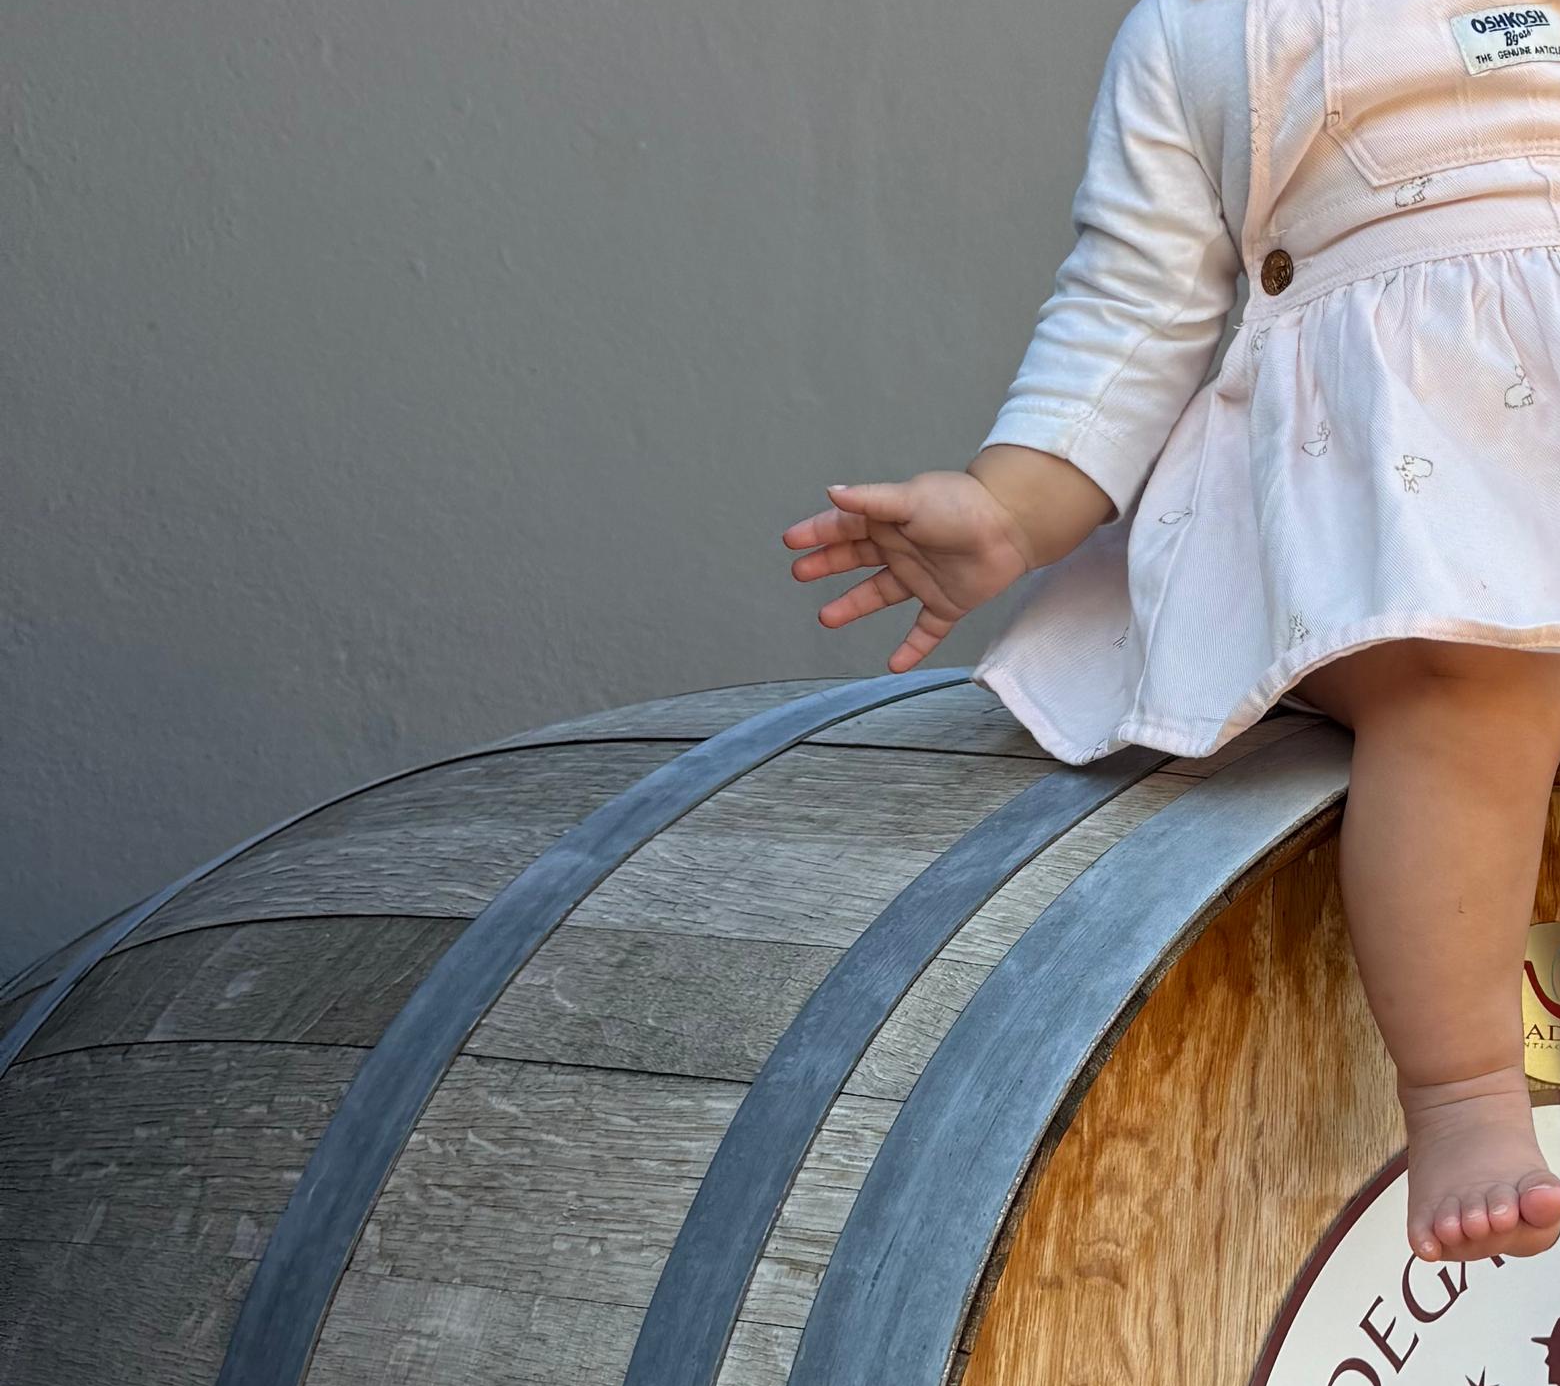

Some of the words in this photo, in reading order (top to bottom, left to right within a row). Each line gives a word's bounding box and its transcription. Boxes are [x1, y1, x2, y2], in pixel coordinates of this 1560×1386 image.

[1470, 9, 1549, 34] OSHKOSH
[1475, 53, 1493, 64] THE
[1497, 45, 1531, 60] GENUINE
